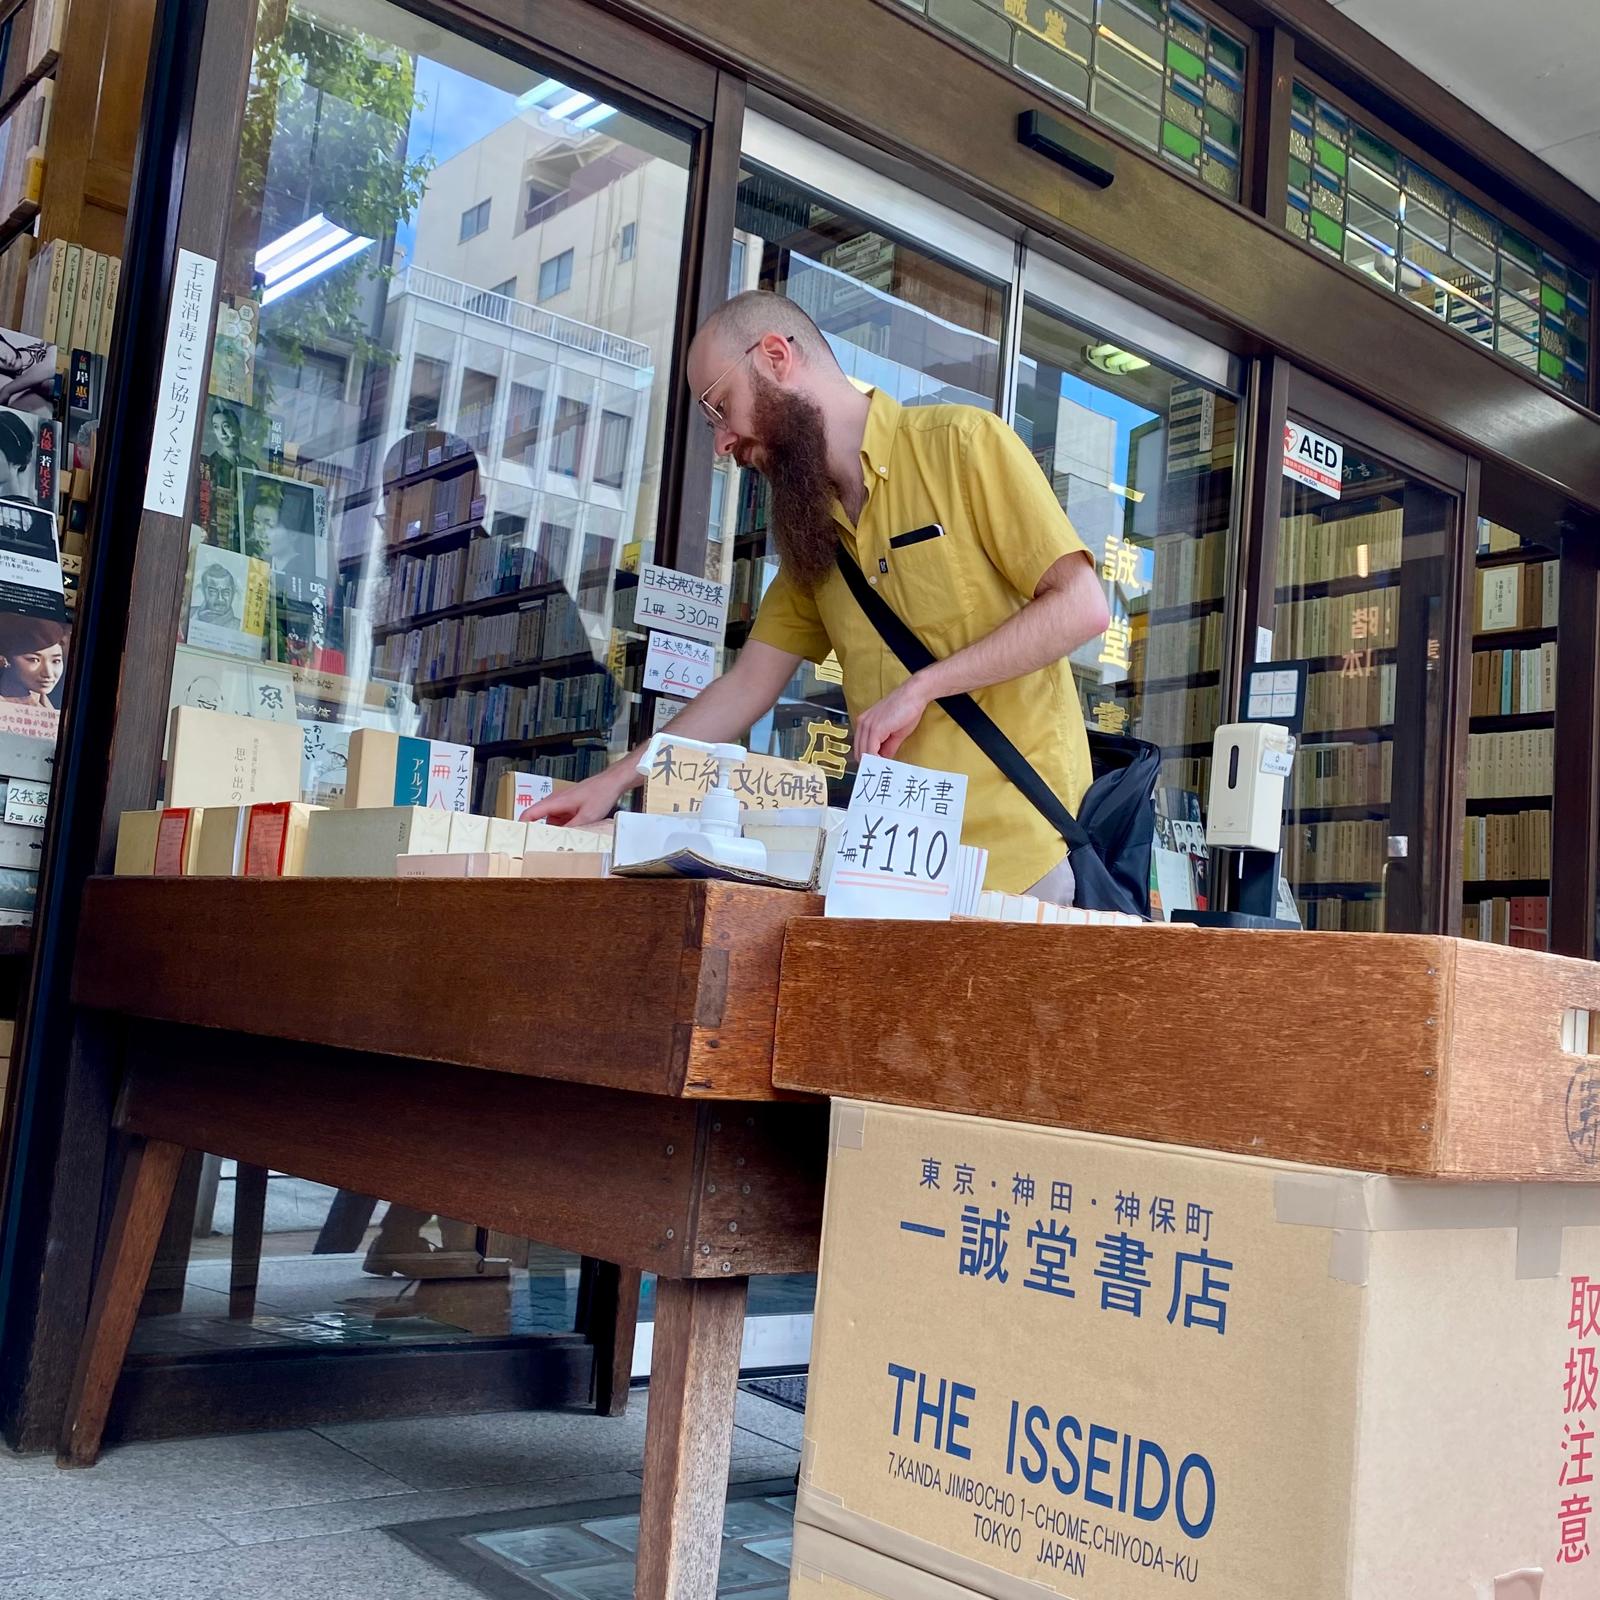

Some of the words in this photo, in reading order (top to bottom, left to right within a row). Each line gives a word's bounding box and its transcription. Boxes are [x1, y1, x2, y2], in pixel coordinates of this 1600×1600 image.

[158, 262, 206, 506] 手指消毒にご協力ください
[1299, 435, 1337, 468] AED
[641, 597, 666, 616] 1冊
[675, 603, 719, 630] 330円
[643, 568, 724, 605] 日本古典文学全集
[657, 702, 681, 718] 古典
[231, 747, 246, 802] 思い出の
[453, 750, 469, 812] アルプス記
[28, 814, 47, 824] 165
[837, 829, 858, 863] 1冊
[859, 813, 948, 881] ¥110
[918, 1156, 1214, 1242] 東京・神田・神保町
[899, 1204, 1234, 1336] 一誠堂書店
[1556, 1275, 1600, 1563] 取扱注意
[887, 1361, 977, 1461] THE
[1005, 1399, 1216, 1540] ISSEIDO
[944, 1477, 1015, 1518] JIMBOCHO
[973, 1513, 1022, 1554] TOKYO
[1036, 1538, 1087, 1578] JAPAN
